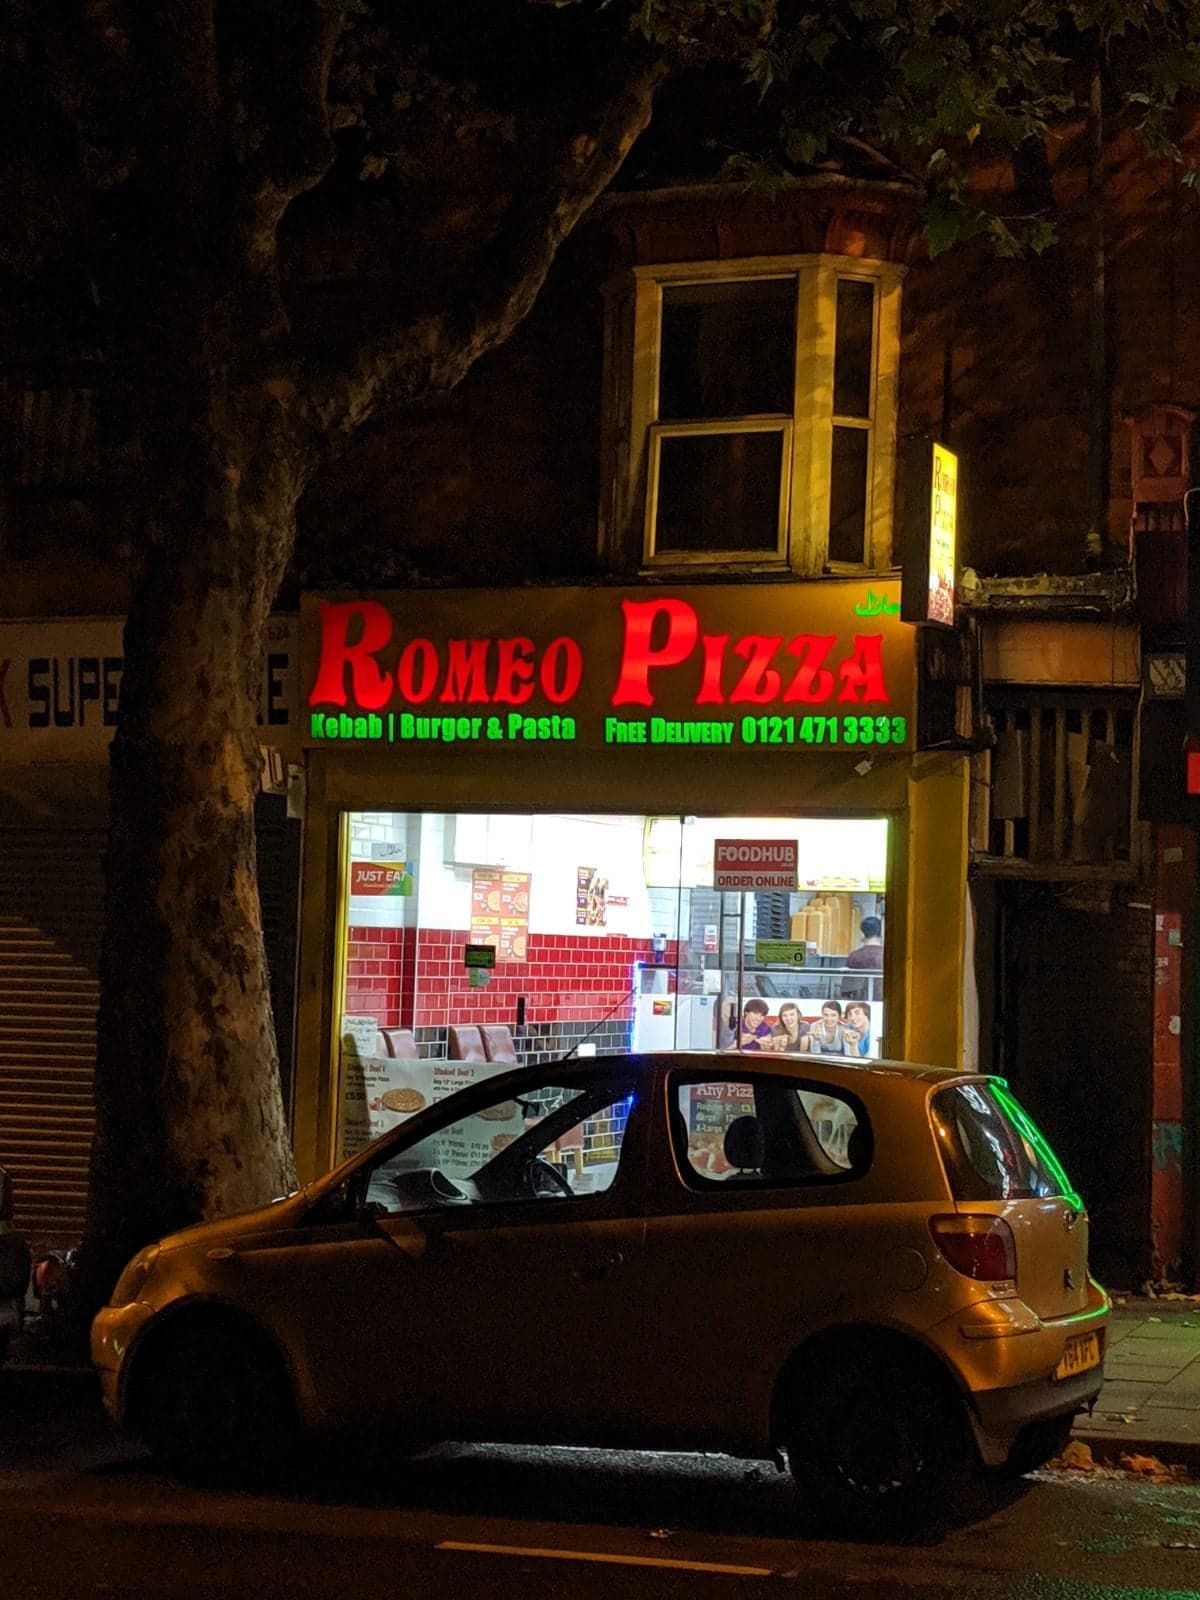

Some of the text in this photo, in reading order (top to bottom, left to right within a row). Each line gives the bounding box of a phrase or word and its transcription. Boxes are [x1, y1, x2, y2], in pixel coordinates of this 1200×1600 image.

[309, 597, 891, 710] ROMEO PIZZA
[28, 657, 124, 727] SUPE
[310, 713, 383, 739] Kebab
[400, 713, 483, 742] Burger
[486, 716, 504, 740] &
[507, 713, 576, 740] Pasta
[605, 716, 906, 745] FREE DELIVERY 0121 471 3333
[718, 846, 795, 863] FOODHUB
[356, 870, 408, 883] JUST EAT
[718, 875, 753, 887] ORDER
[755, 876, 795, 887] ONLINE
[697, 1085, 753, 1098] Any Pizz
